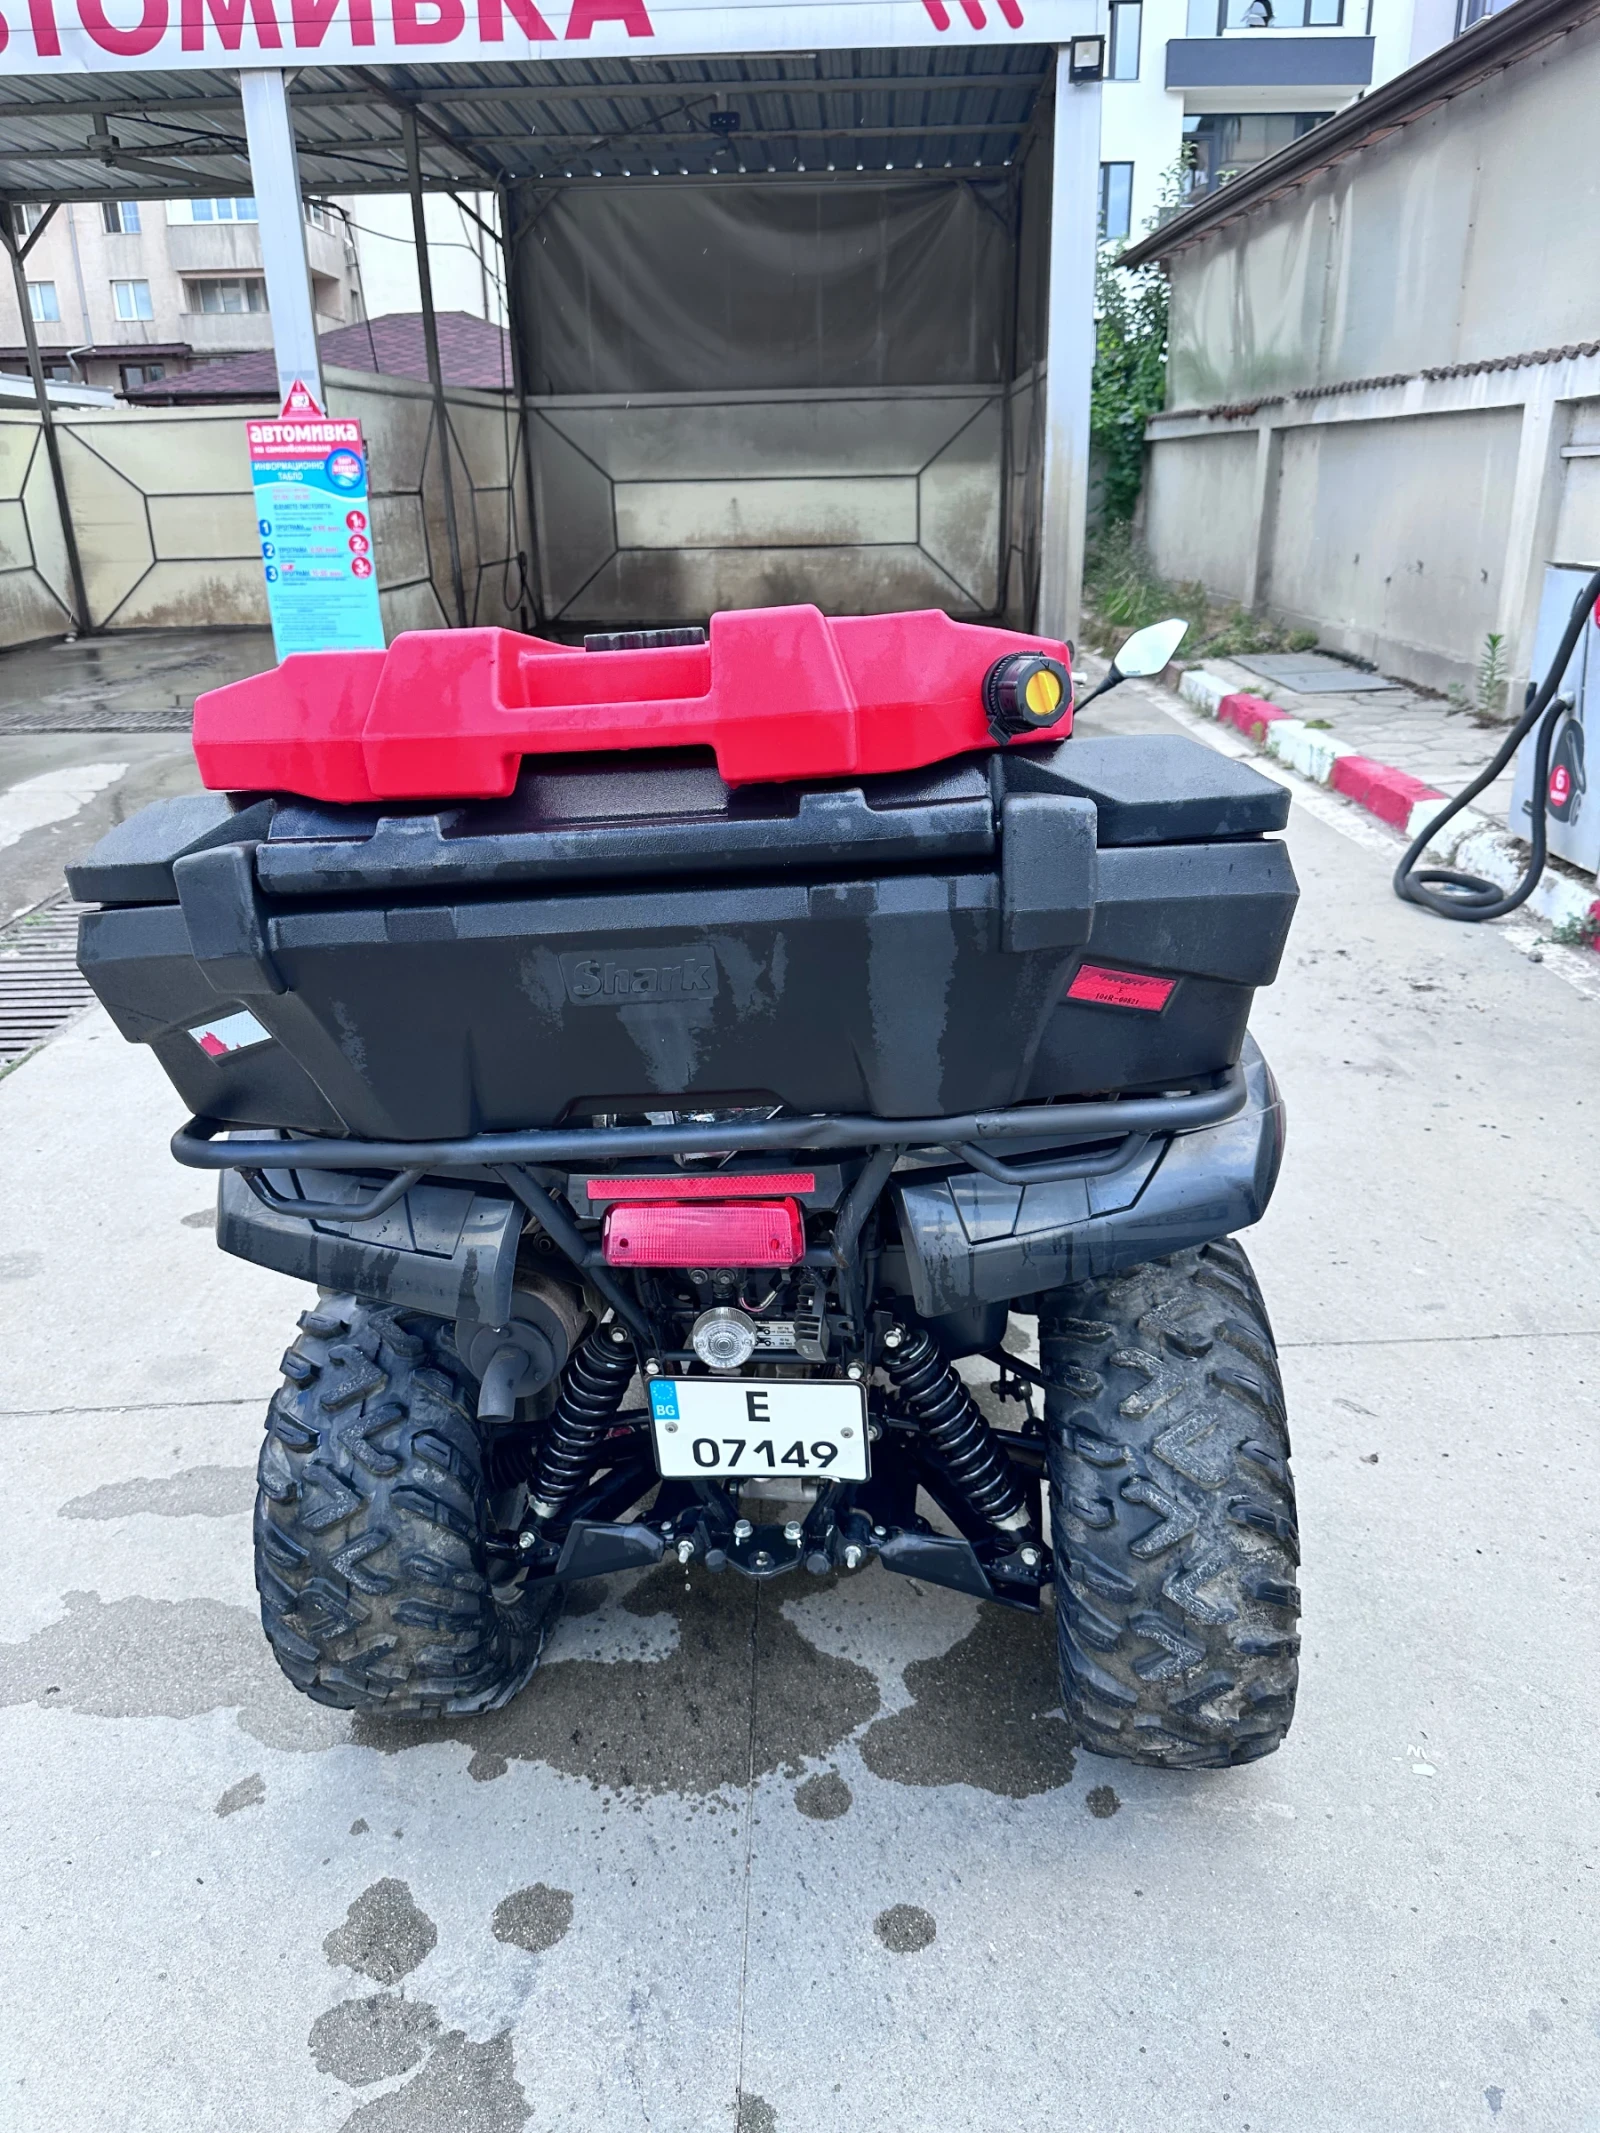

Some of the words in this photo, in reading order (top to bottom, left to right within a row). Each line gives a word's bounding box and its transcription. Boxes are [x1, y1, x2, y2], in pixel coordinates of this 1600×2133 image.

[266, 544, 274, 557] 2
[269, 568, 277, 581] 3
[1556, 768, 1565, 790] 6
[573, 958, 711, 997] Shark
[656, 1405, 676, 1416] BG
[745, 1391, 770, 1422] E
[692, 1437, 839, 1469] 07149
